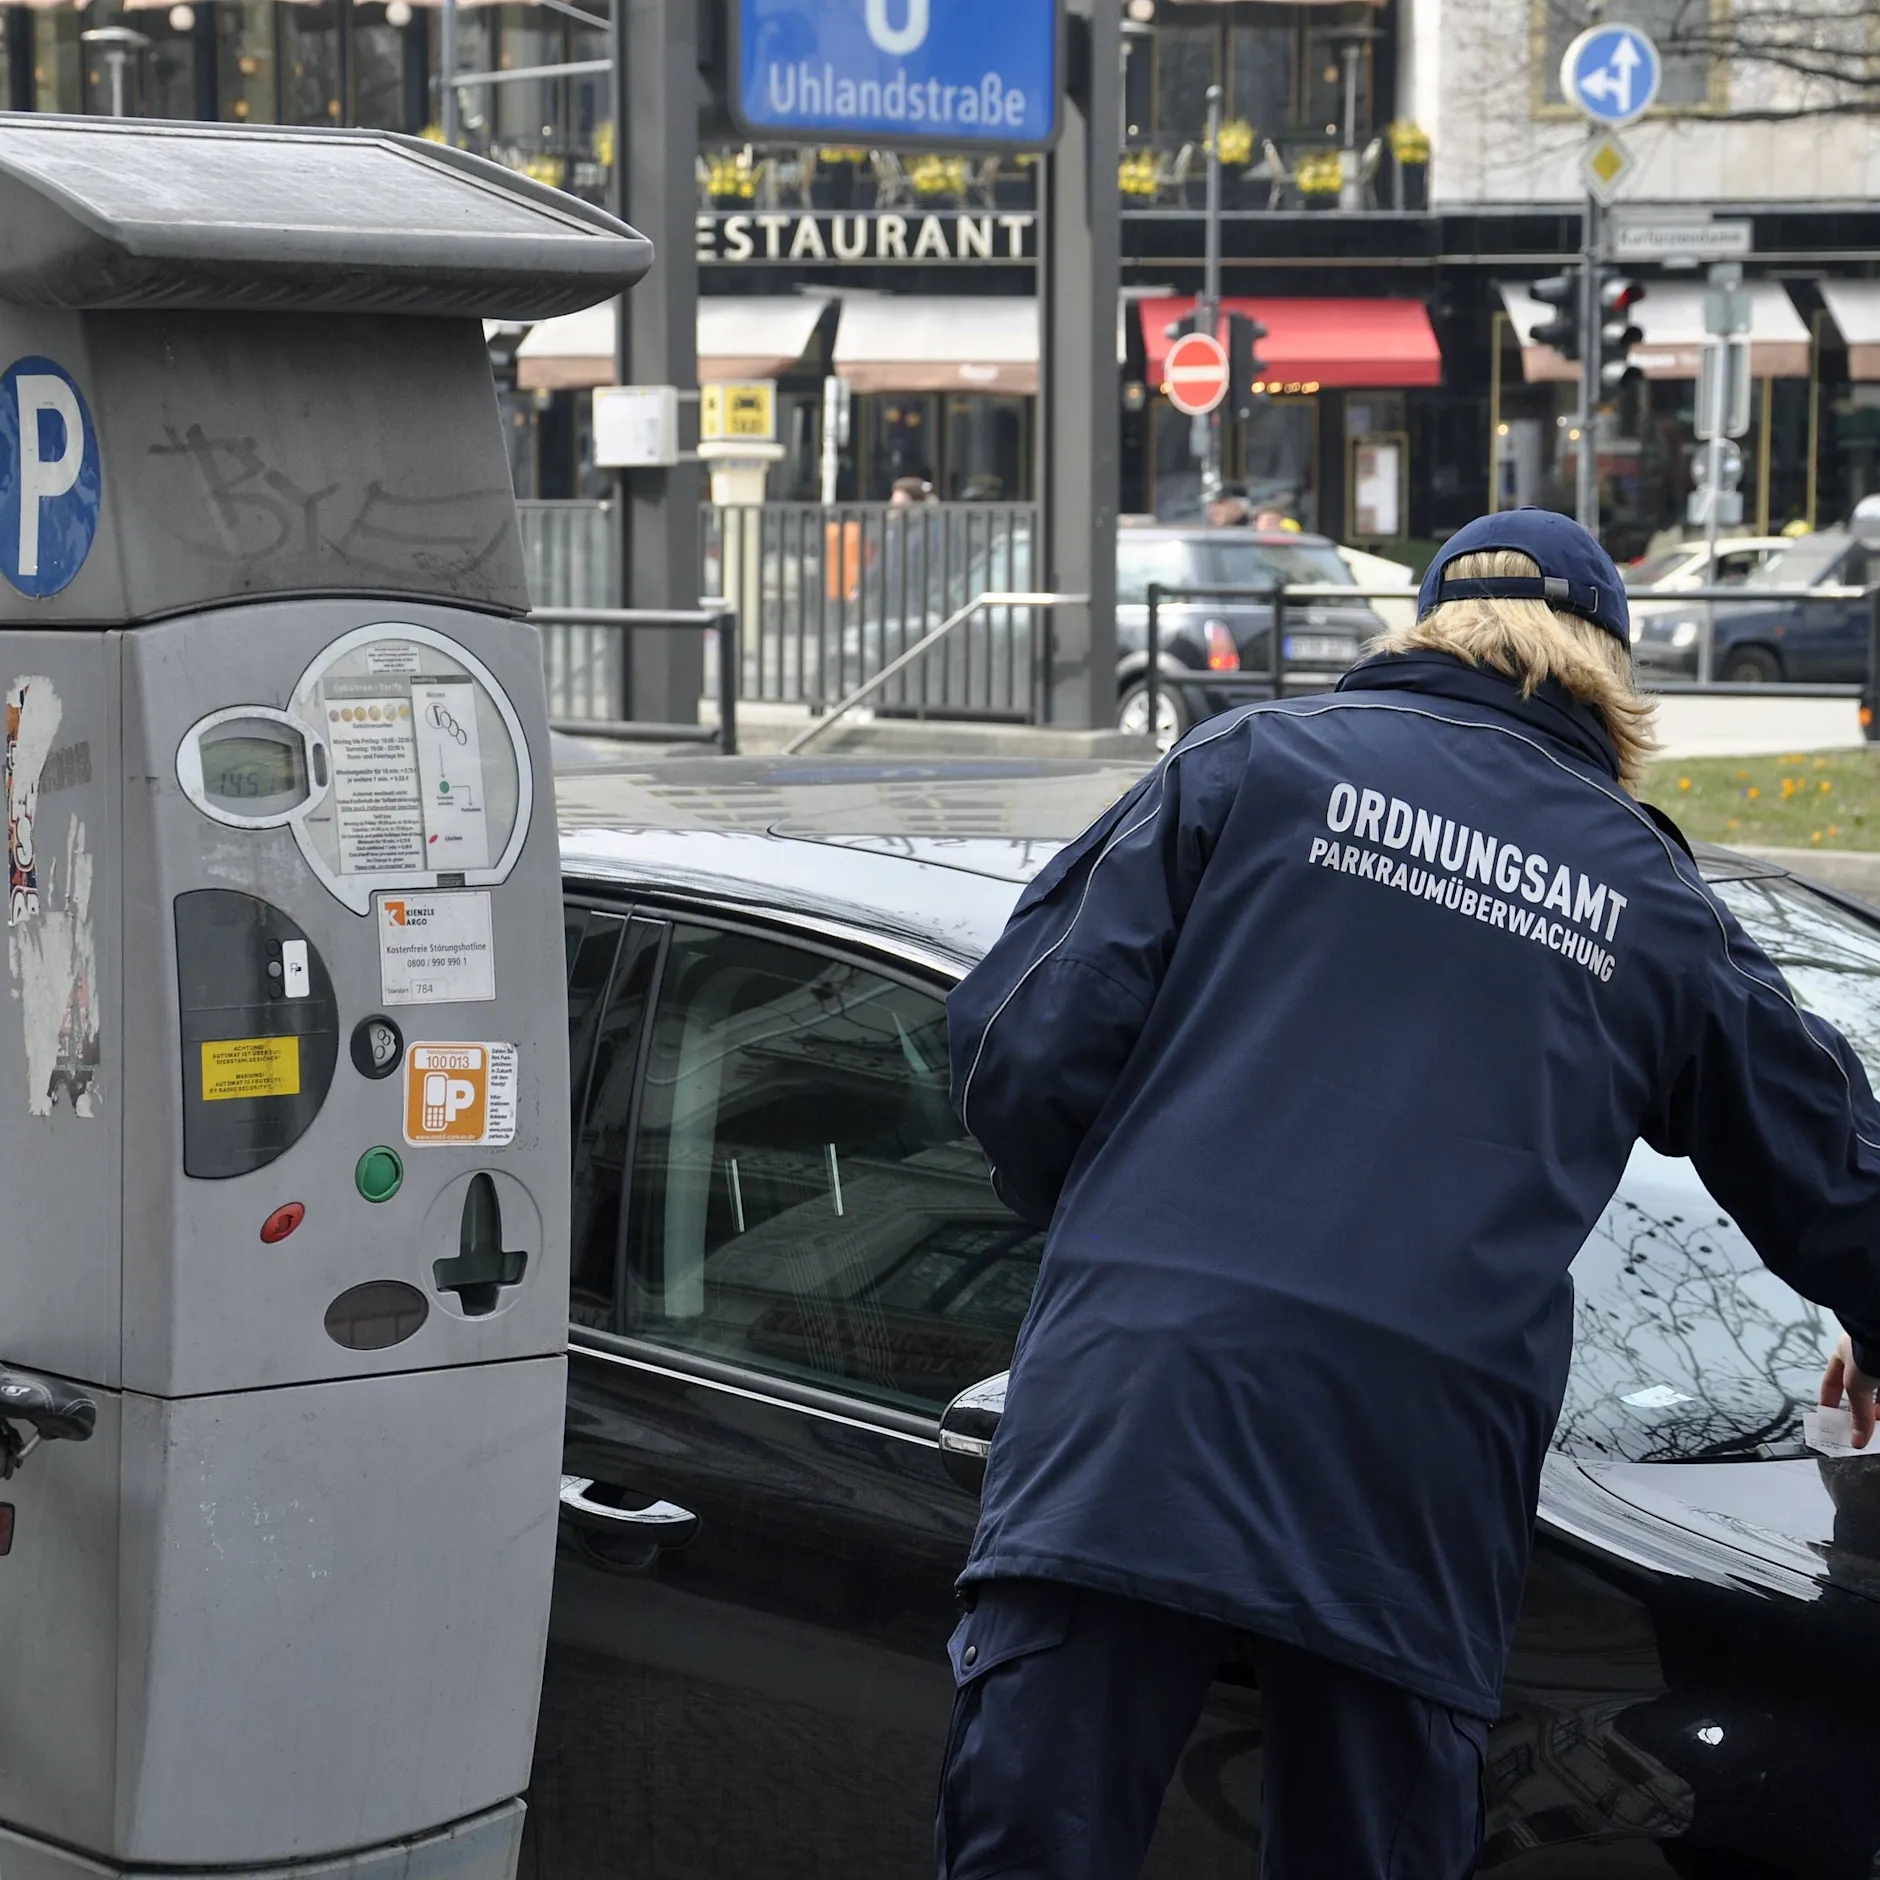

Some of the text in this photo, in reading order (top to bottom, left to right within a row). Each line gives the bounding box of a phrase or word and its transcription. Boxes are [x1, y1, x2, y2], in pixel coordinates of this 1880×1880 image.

[769, 62, 1026, 128] Uhlandstraße
[16, 374, 84, 575] P
[1326, 782, 1628, 943] ORDNUNGSAMT
[1308, 837, 1616, 983] PARKRAUMÜBERWACHUNG
[386, 942, 486, 954] Kostenfreie Störungshotline
[417, 984, 433, 994] 784
[427, 1056, 469, 1069] 100 013
[446, 1080, 475, 1121] P
